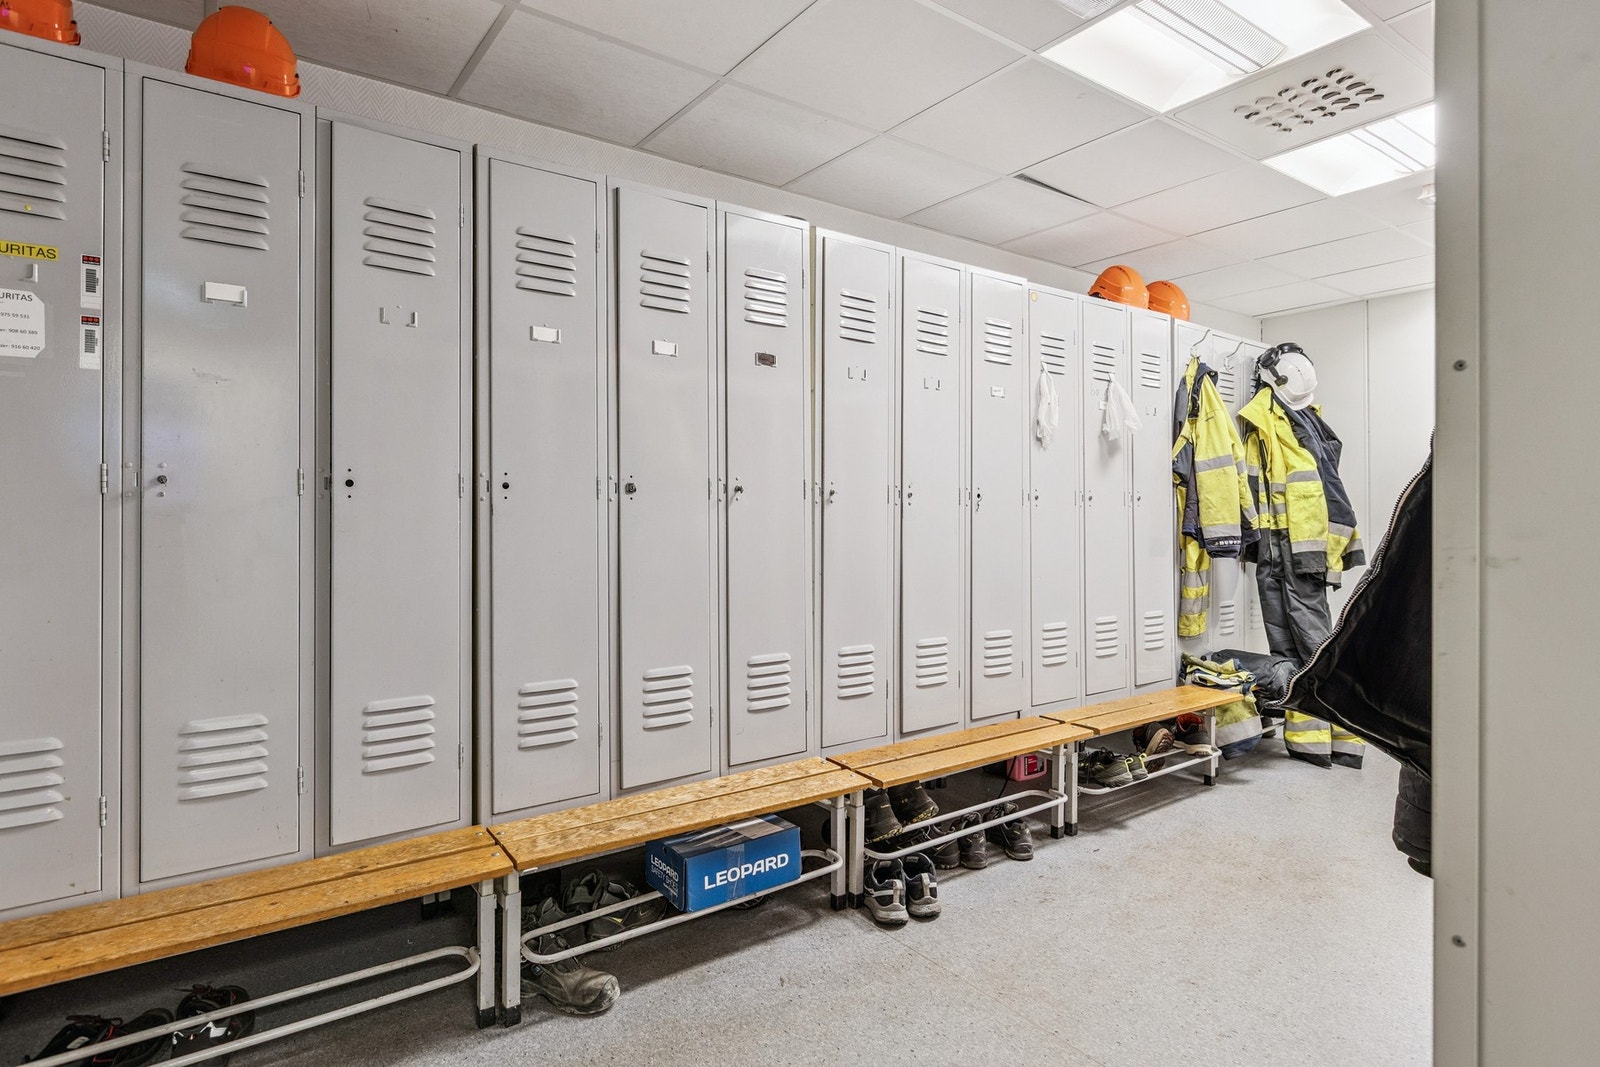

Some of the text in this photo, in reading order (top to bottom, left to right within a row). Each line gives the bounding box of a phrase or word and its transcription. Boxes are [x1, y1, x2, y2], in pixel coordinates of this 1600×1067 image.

[0, 242, 57, 259] URITAS
[0, 292, 33, 302] URITAS
[650, 854, 679, 882] LEOPARD
[704, 853, 789, 890] LEOPARD
